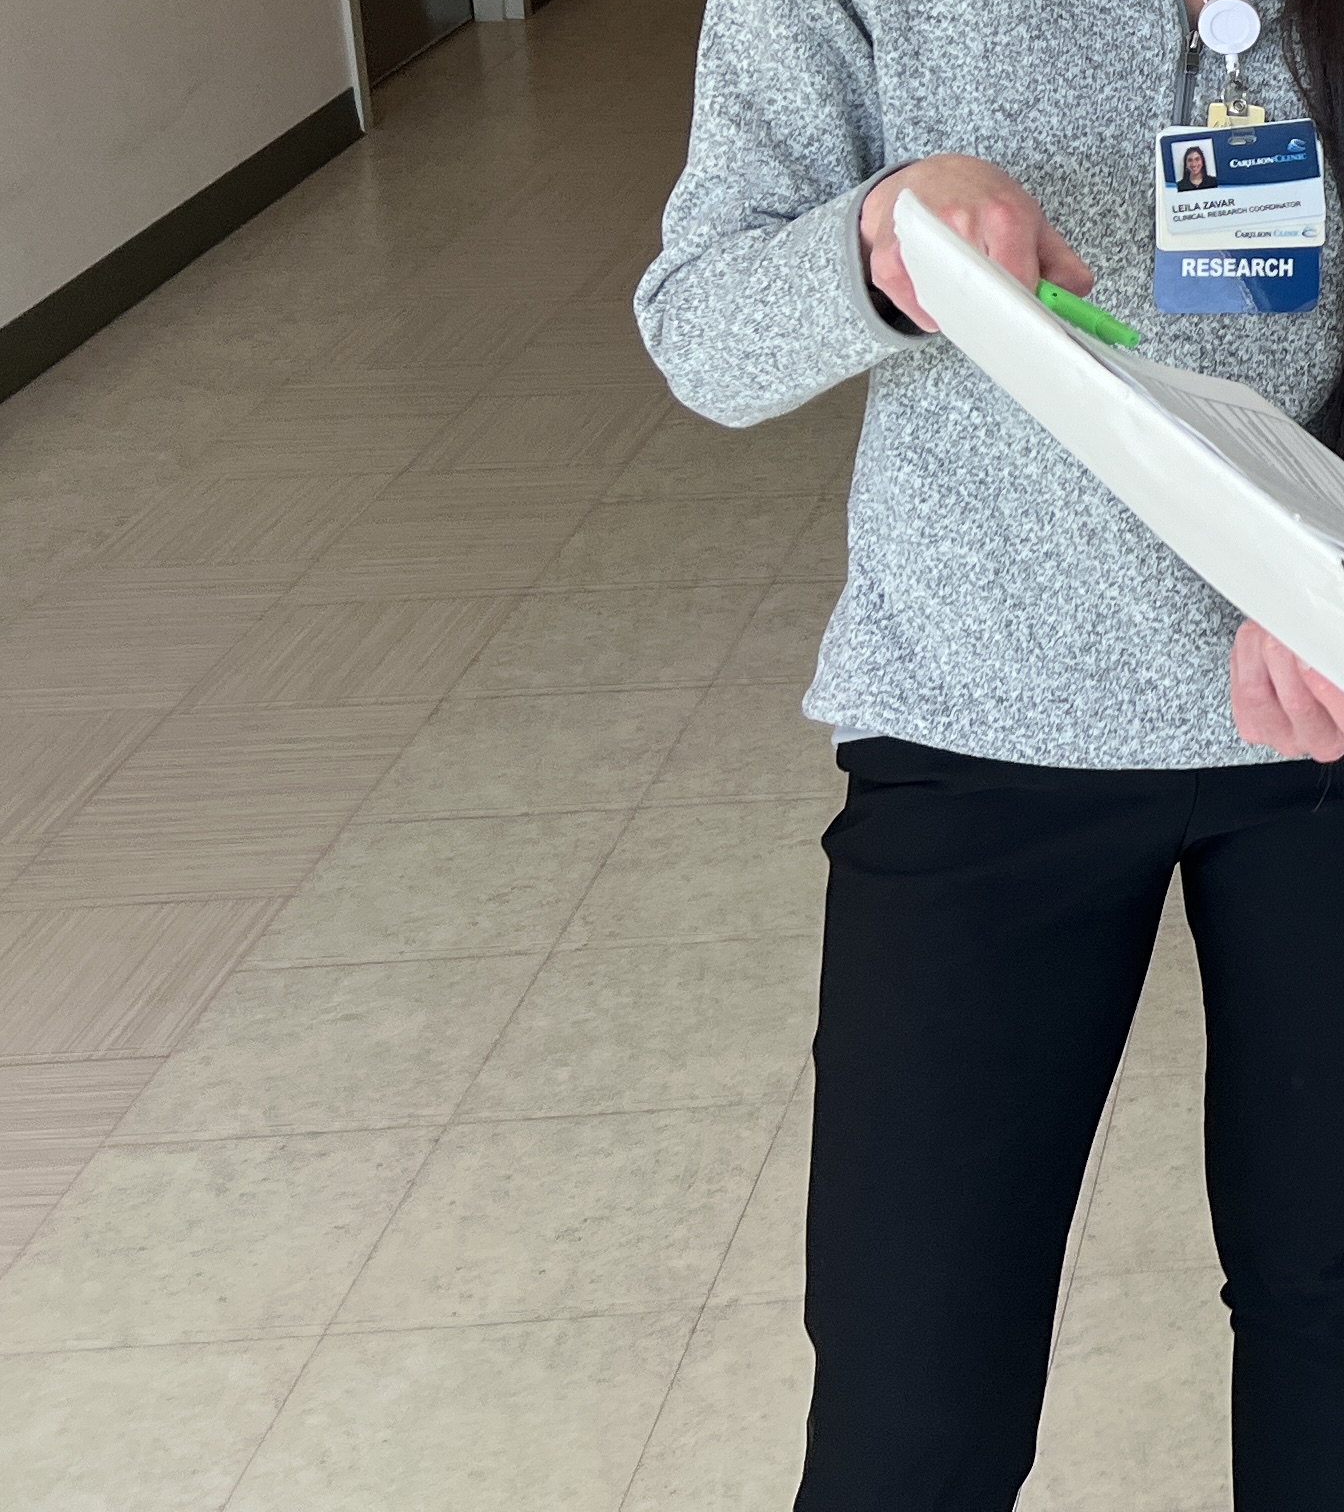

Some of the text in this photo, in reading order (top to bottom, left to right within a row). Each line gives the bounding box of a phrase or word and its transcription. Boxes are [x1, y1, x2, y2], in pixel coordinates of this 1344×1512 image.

[1172, 198, 1236, 214] LEILA ZAVAR
[1172, 201, 1301, 223] CLINICAL RESEARCH COORDINATOR
[1182, 258, 1293, 277] RESEARCH
